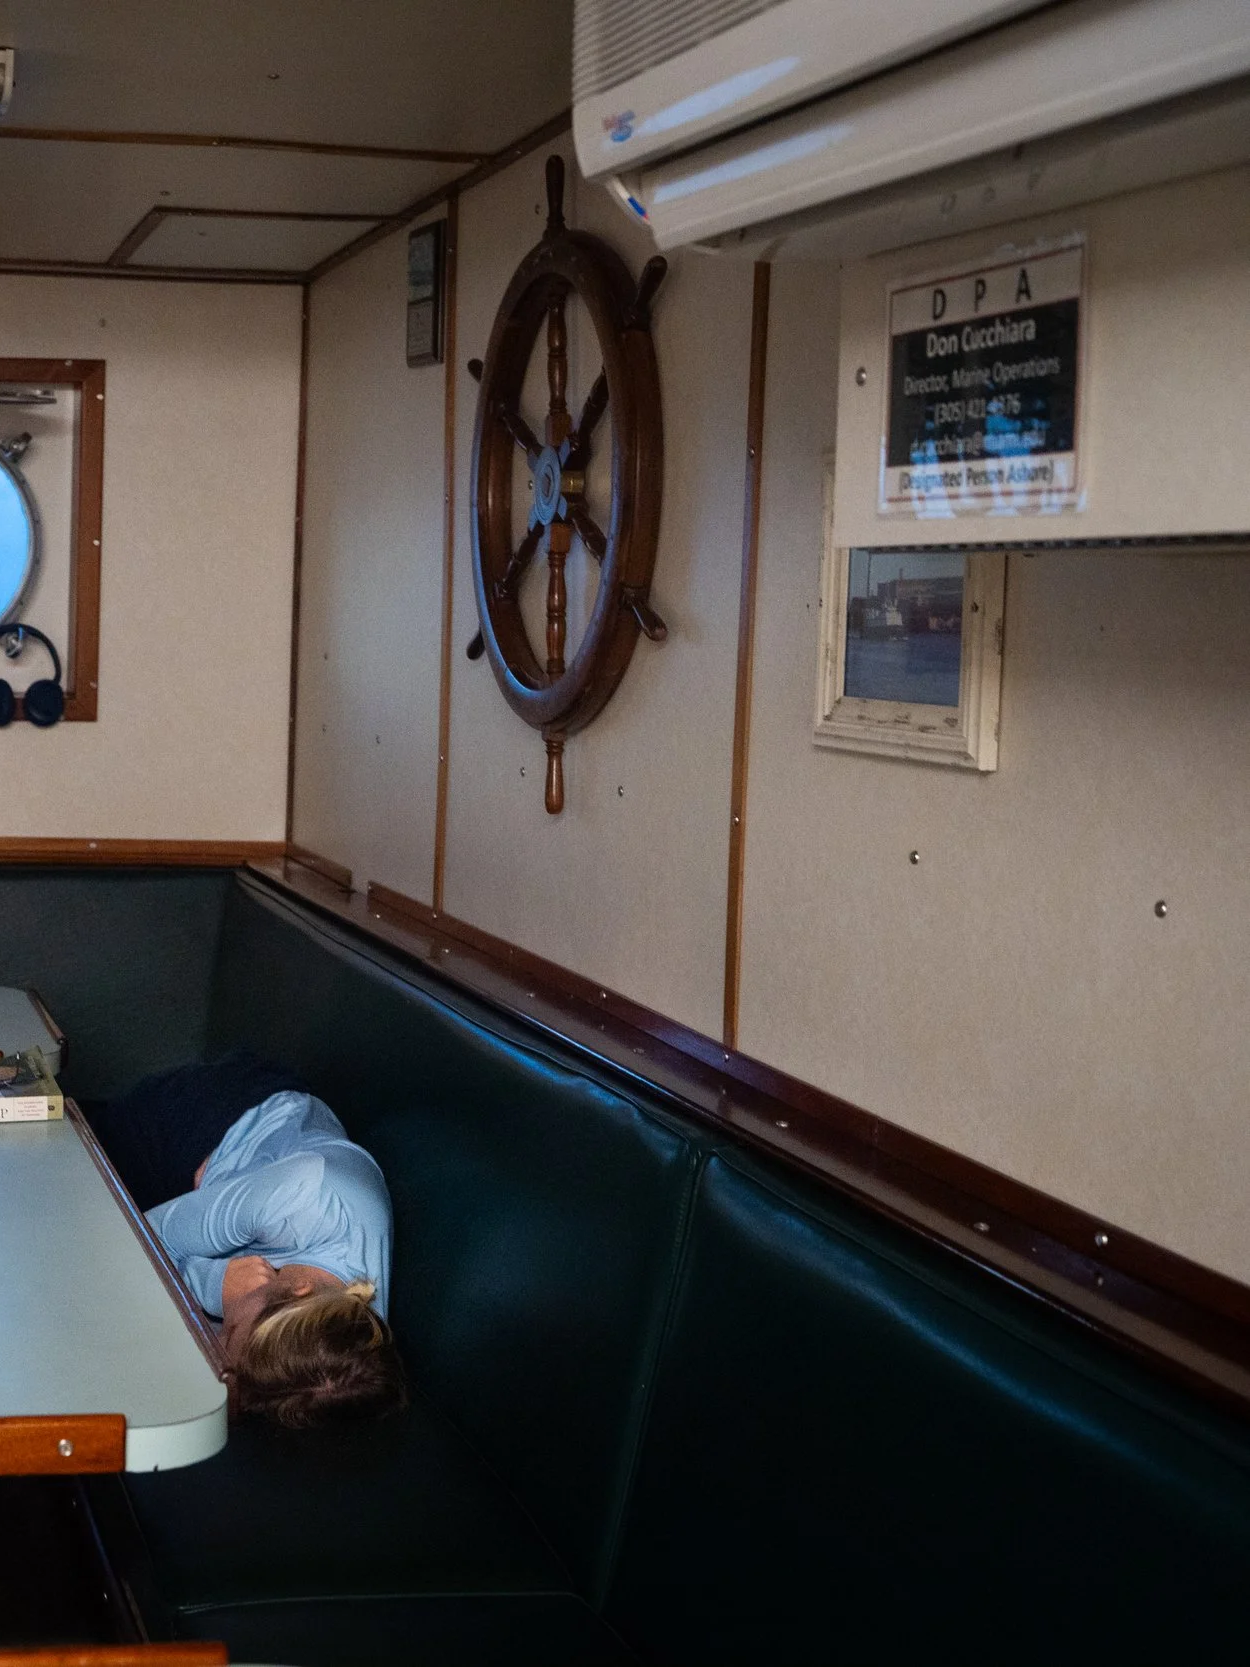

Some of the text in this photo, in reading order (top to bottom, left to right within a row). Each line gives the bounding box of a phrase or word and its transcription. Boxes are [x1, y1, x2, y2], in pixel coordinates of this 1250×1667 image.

[926, 318, 1037, 358] Don Cucchiara
[952, 367, 991, 389] Marine
[992, 357, 1060, 384] Operations
[967, 465, 1004, 486] Person
